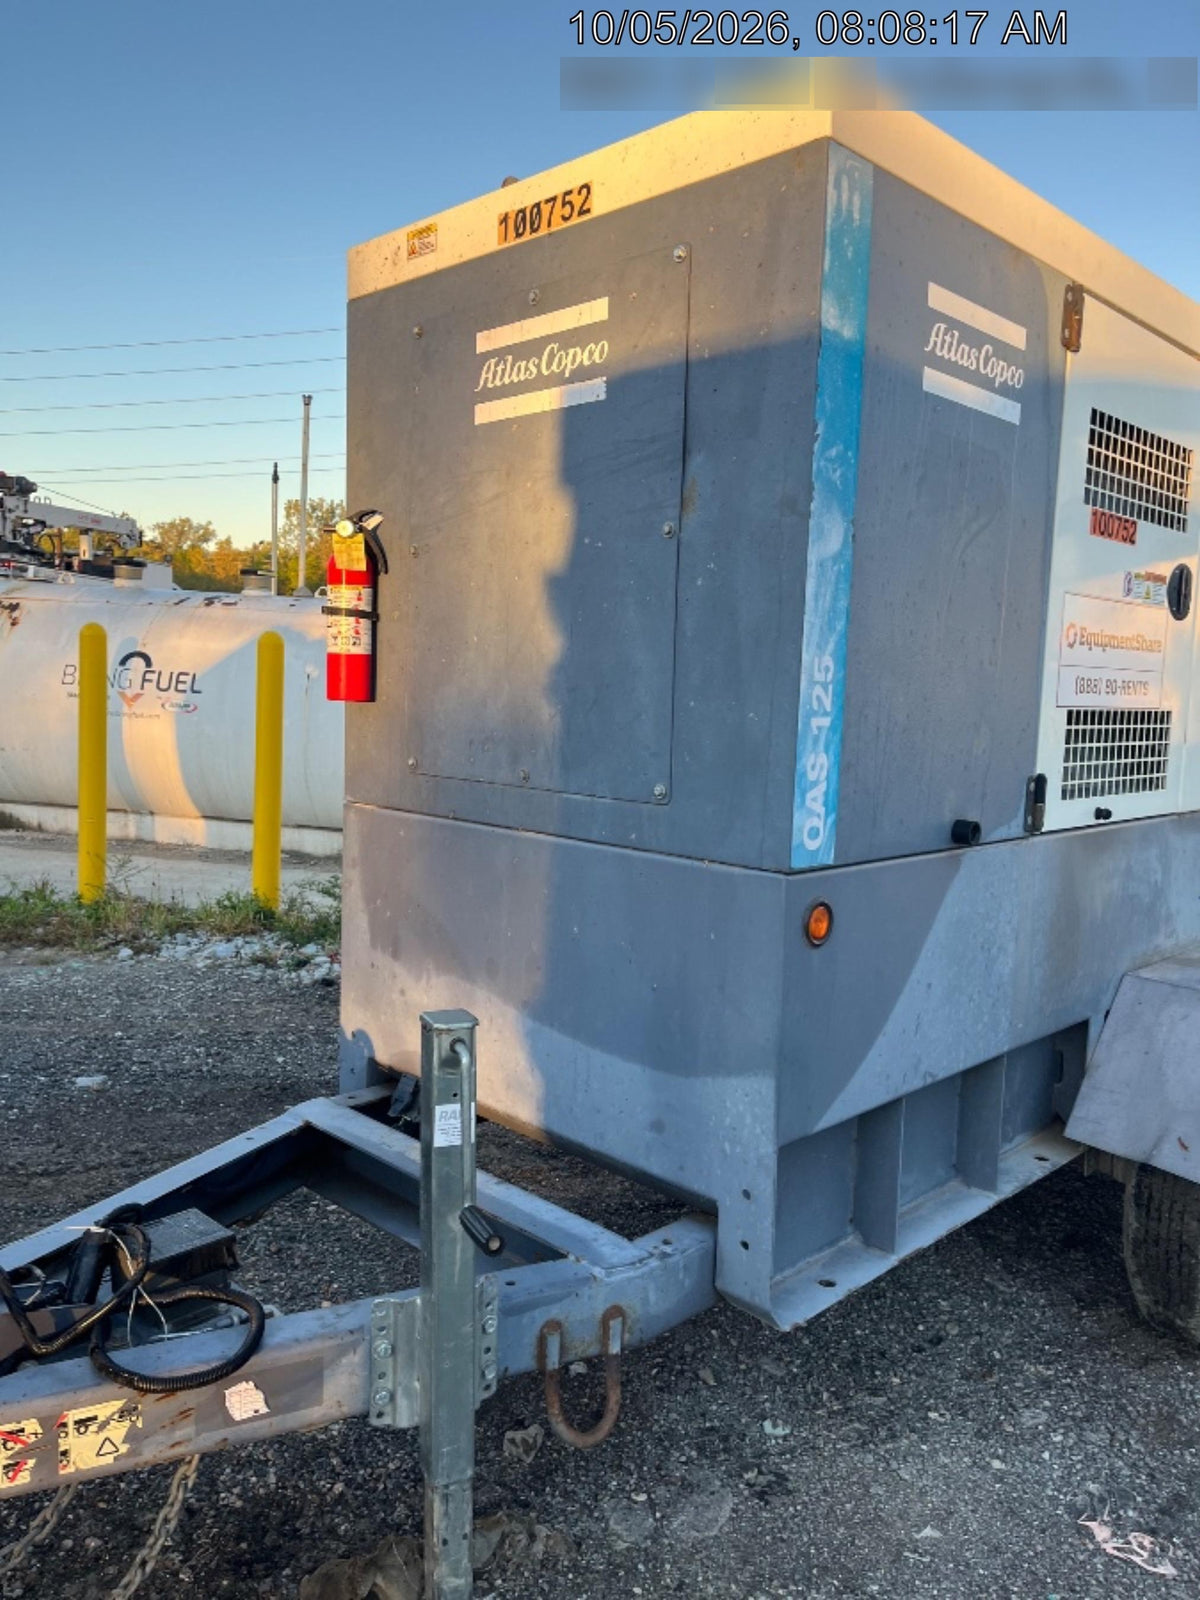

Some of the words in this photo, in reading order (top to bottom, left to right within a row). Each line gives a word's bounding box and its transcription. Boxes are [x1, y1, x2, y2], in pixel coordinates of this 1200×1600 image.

[499, 182, 592, 243] 100752
[474, 354, 540, 392] Atlas
[541, 340, 609, 378] Copco
[924, 322, 978, 370] Atlas
[980, 344, 1025, 389] Copco
[1091, 509, 1138, 545] 100752
[1079, 626, 1162, 653] EquipmentShare
[140, 669, 203, 695] FUEL
[810, 655, 835, 735] 125
[803, 752, 829, 851] QAS
